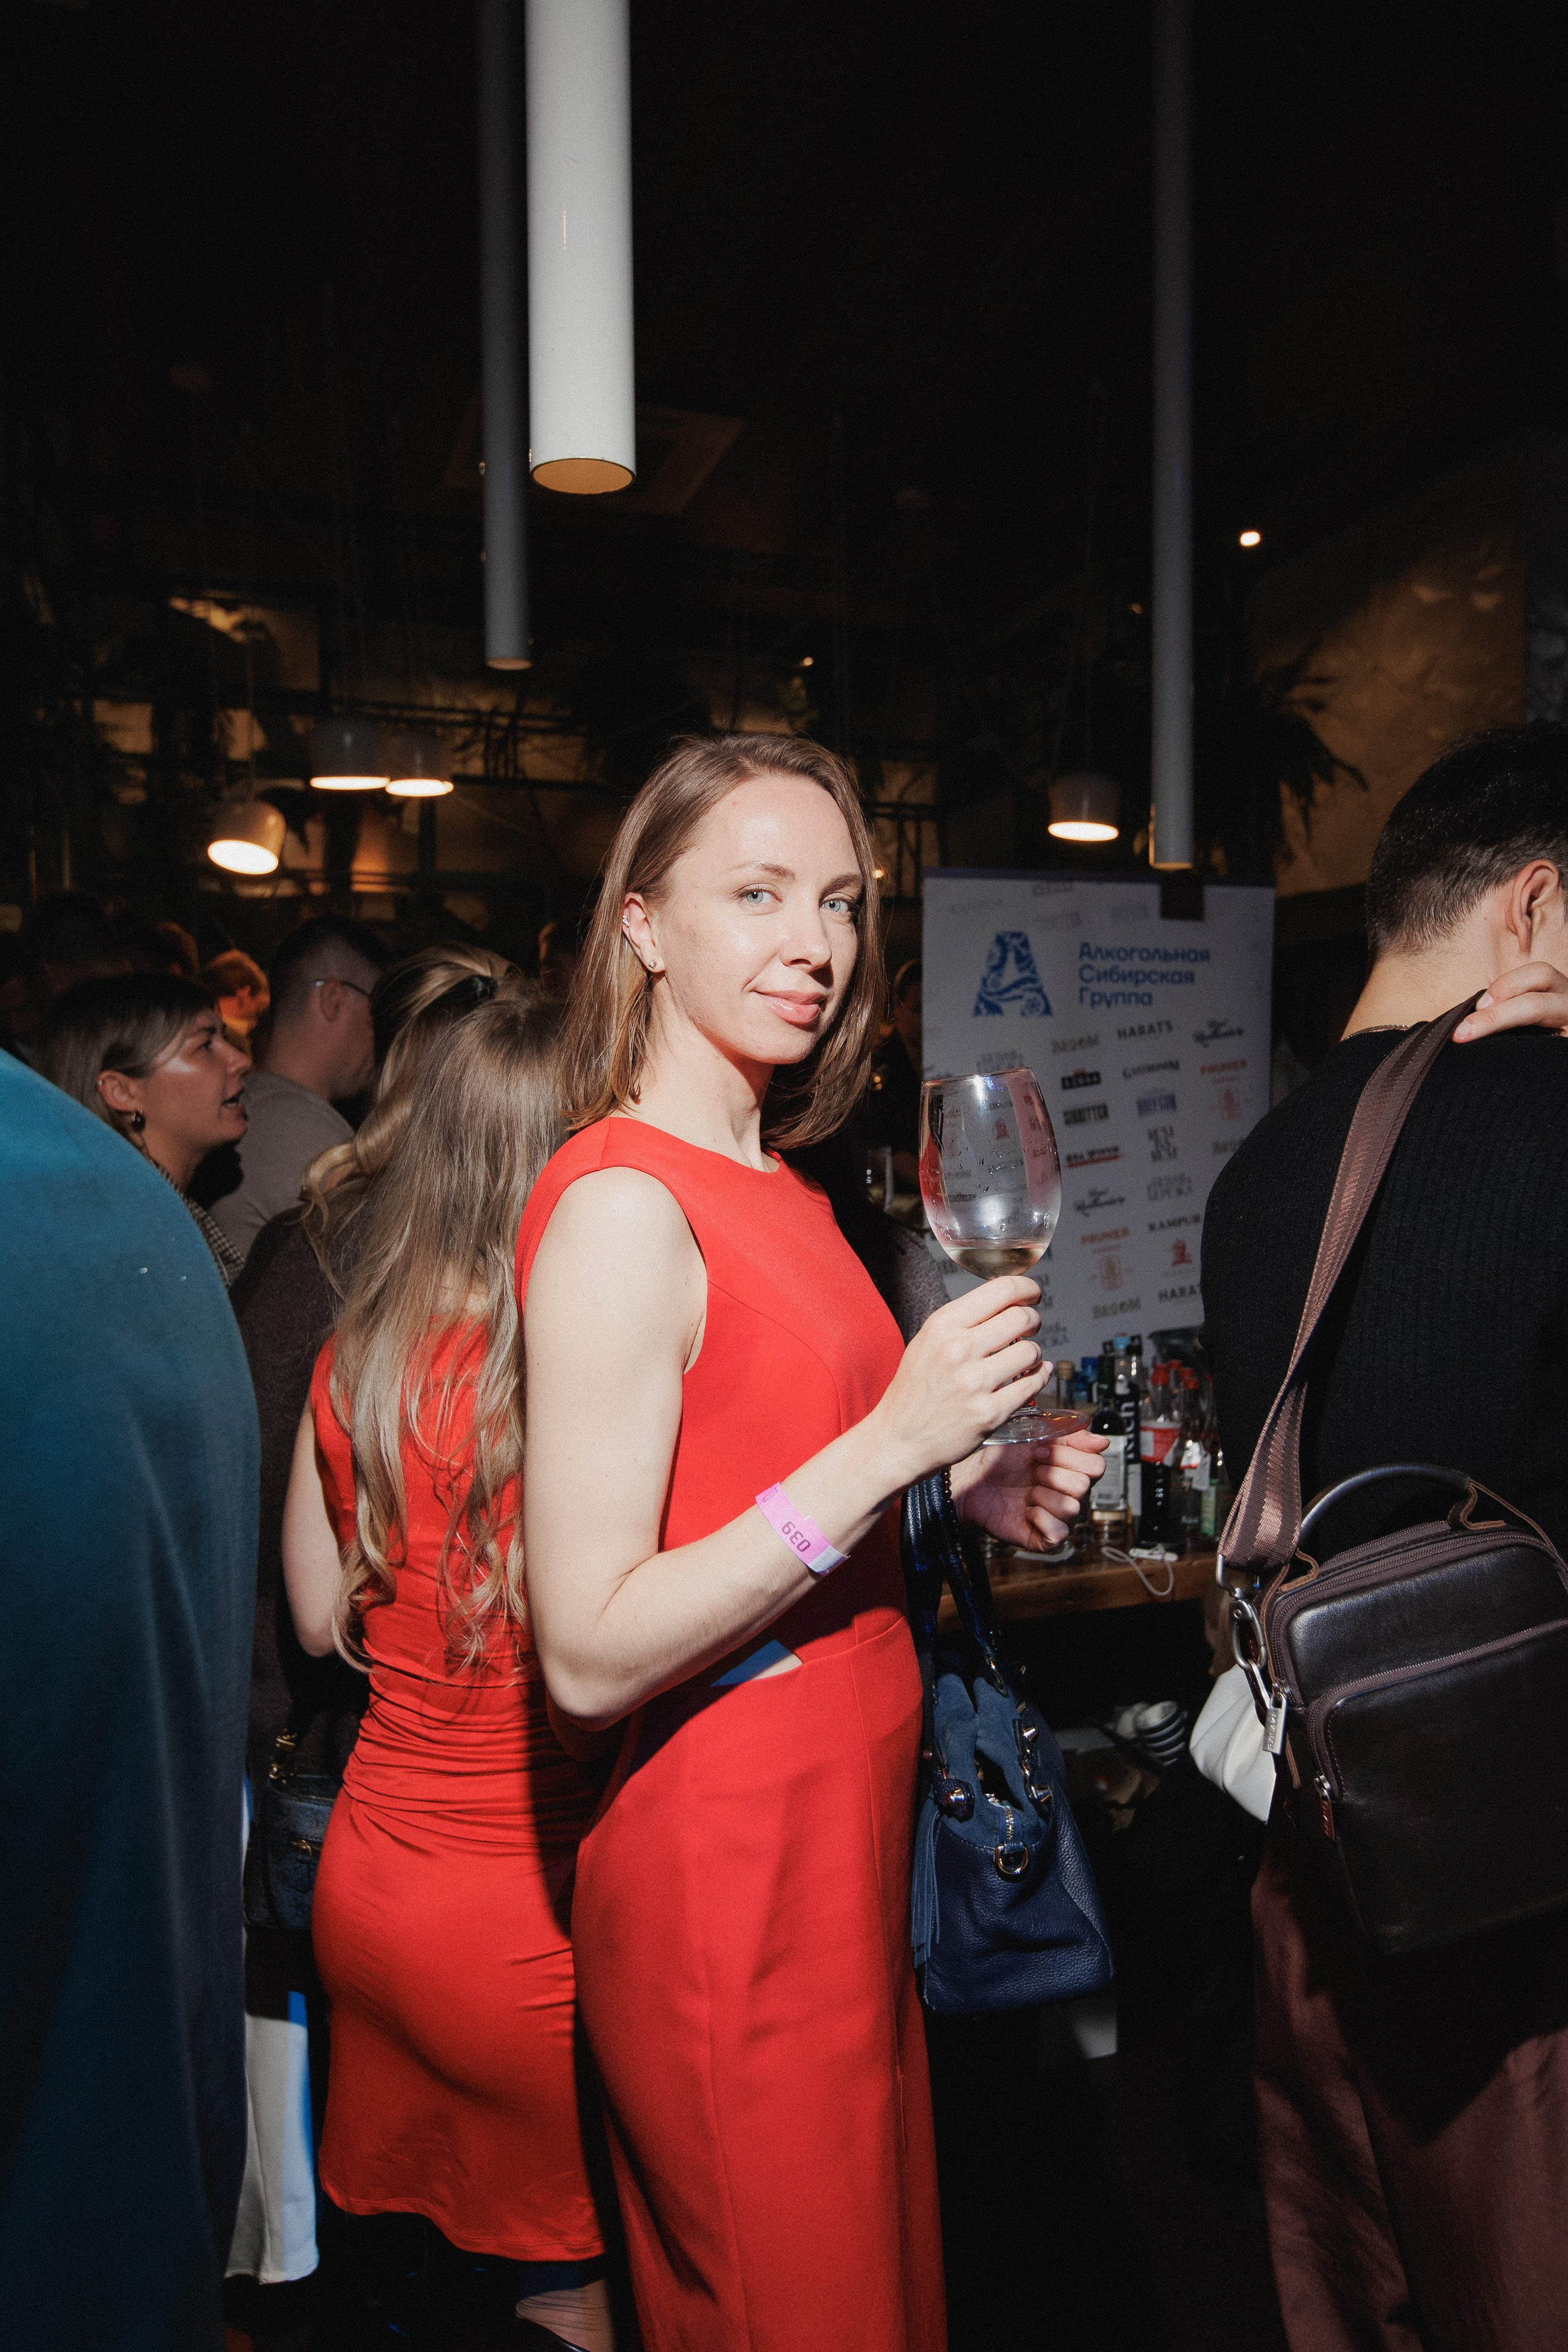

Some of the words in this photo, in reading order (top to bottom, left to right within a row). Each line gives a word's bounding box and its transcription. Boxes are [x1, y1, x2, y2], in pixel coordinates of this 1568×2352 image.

[1079, 942, 1210, 963] Алкогольная
[1079, 965, 1195, 986] Сибирская
[1079, 987, 1153, 1008] Группа
[1159, 1284, 1202, 1302] HARA
[782, 1521, 811, 1552] 039
